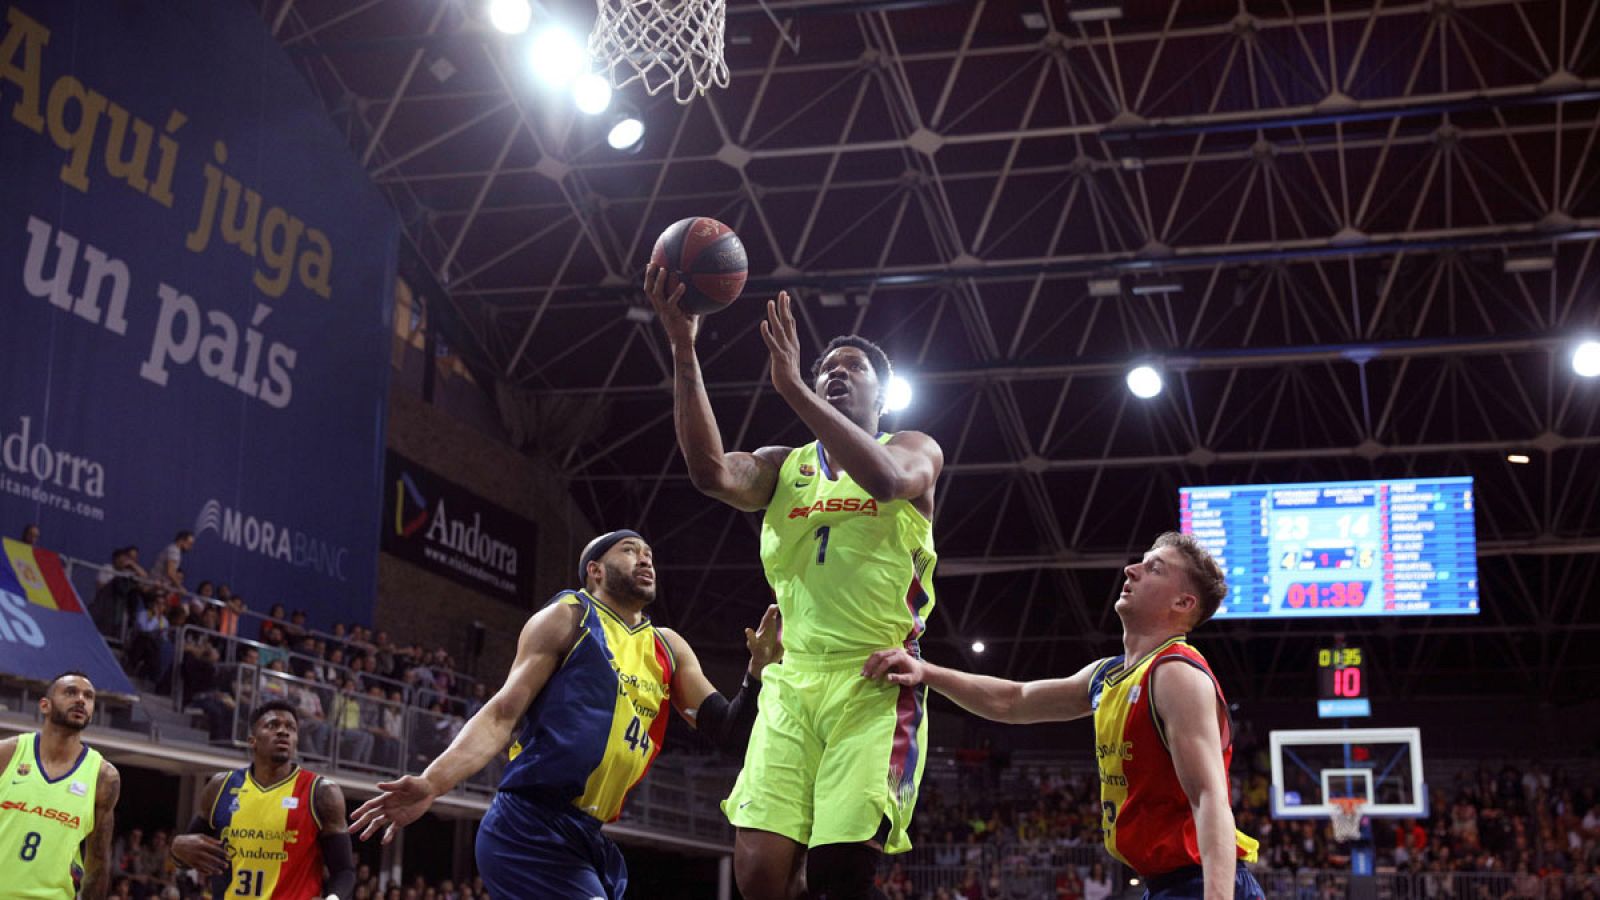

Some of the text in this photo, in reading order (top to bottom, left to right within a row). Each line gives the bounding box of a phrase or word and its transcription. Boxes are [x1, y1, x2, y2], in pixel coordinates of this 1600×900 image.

[0, 5, 332, 298] Aquí juga
[23, 215, 297, 408] un país
[0, 416, 104, 498] dorra
[806, 498, 878, 513] ASSA
[222, 507, 348, 581] MORABANC
[425, 498, 518, 576] Andorra
[1275, 515, 1309, 541] 23
[1337, 513, 1370, 540] 14
[814, 525, 831, 565] 1
[1334, 667, 1360, 697] 10
[624, 715, 650, 757] 44
[19, 801, 80, 826] LASSA
[20, 831, 42, 862] 8
[239, 847, 288, 861] Andorra
[235, 869, 264, 897] 31
